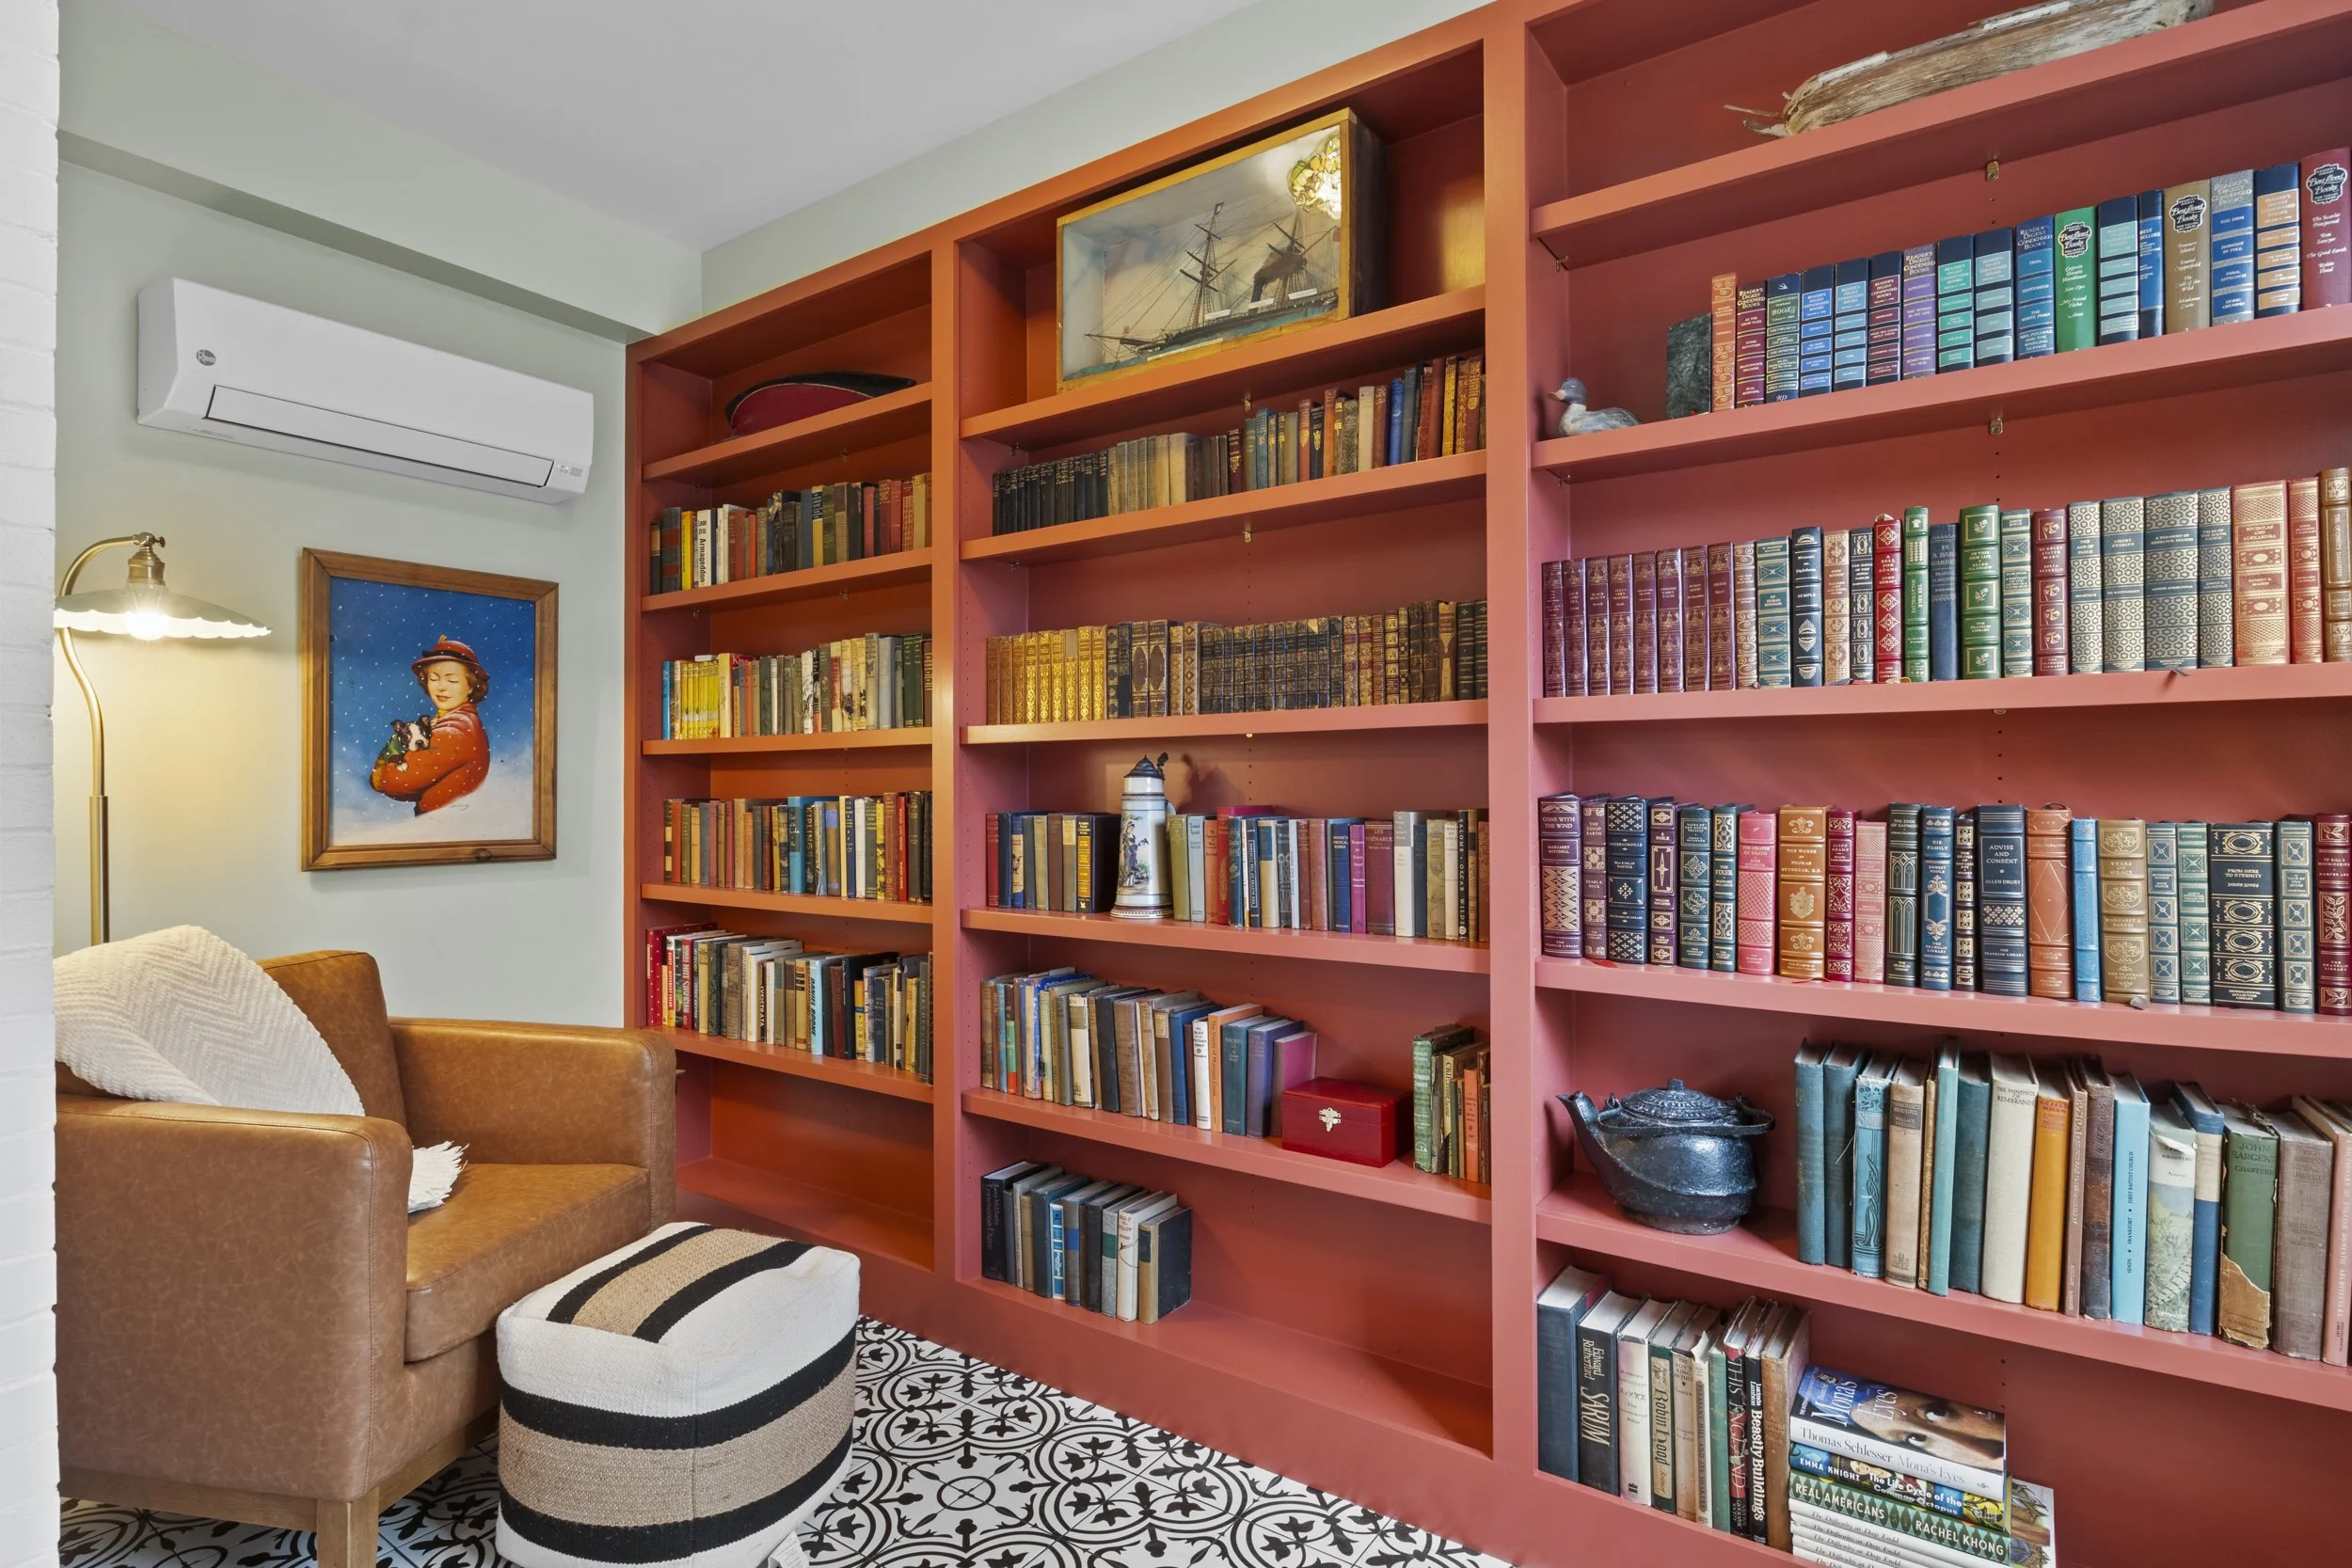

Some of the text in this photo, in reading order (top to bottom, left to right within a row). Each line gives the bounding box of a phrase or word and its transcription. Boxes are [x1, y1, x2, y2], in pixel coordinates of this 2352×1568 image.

[2017, 234, 2053, 246] CONDENSED
[2023, 230, 2046, 240] DIGEST
[2024, 240, 2046, 250] BOOKS
[2139, 232, 2161, 241] SELLERS
[1738, 296, 1766, 306] CONDENSED
[2007, 1086, 2036, 1097] PAINTINGS
[2232, 1150, 2277, 1164] SARGENT
[2238, 1142, 2270, 1153] JOHN
[1592, 1346, 1605, 1377] Edward
[1581, 1385, 1611, 1447] SARUM
[1654, 1388, 1670, 1423] Robin
[1810, 1380, 1858, 1428] Mona's
[1851, 1388, 1900, 1422] Eyes
[1727, 1359, 1749, 1488] THIS ENGLAND
[1655, 1428, 1670, 1466] Hood
[1800, 1425, 1966, 1485] Thomas Schlesser Mona's Eyes
[1751, 1410, 1766, 1521] Beastly Buildings
[1800, 1457, 1862, 1482] EMMA KNIGHT
[1868, 1473, 1963, 1509] The Life Cycle of the
[1873, 1483, 1959, 1516] Common Octopus
[1794, 1481, 2006, 1558] REAL AMERICANS RACHEL KHONG
[1824, 1515, 1852, 1530] Difficulty
[1853, 1525, 1862, 1533] at
[1826, 1528, 1855, 1544] Difficulty
[1826, 1538, 1854, 1554] Difficulty
[1828, 1550, 1856, 1566] Difficulty
